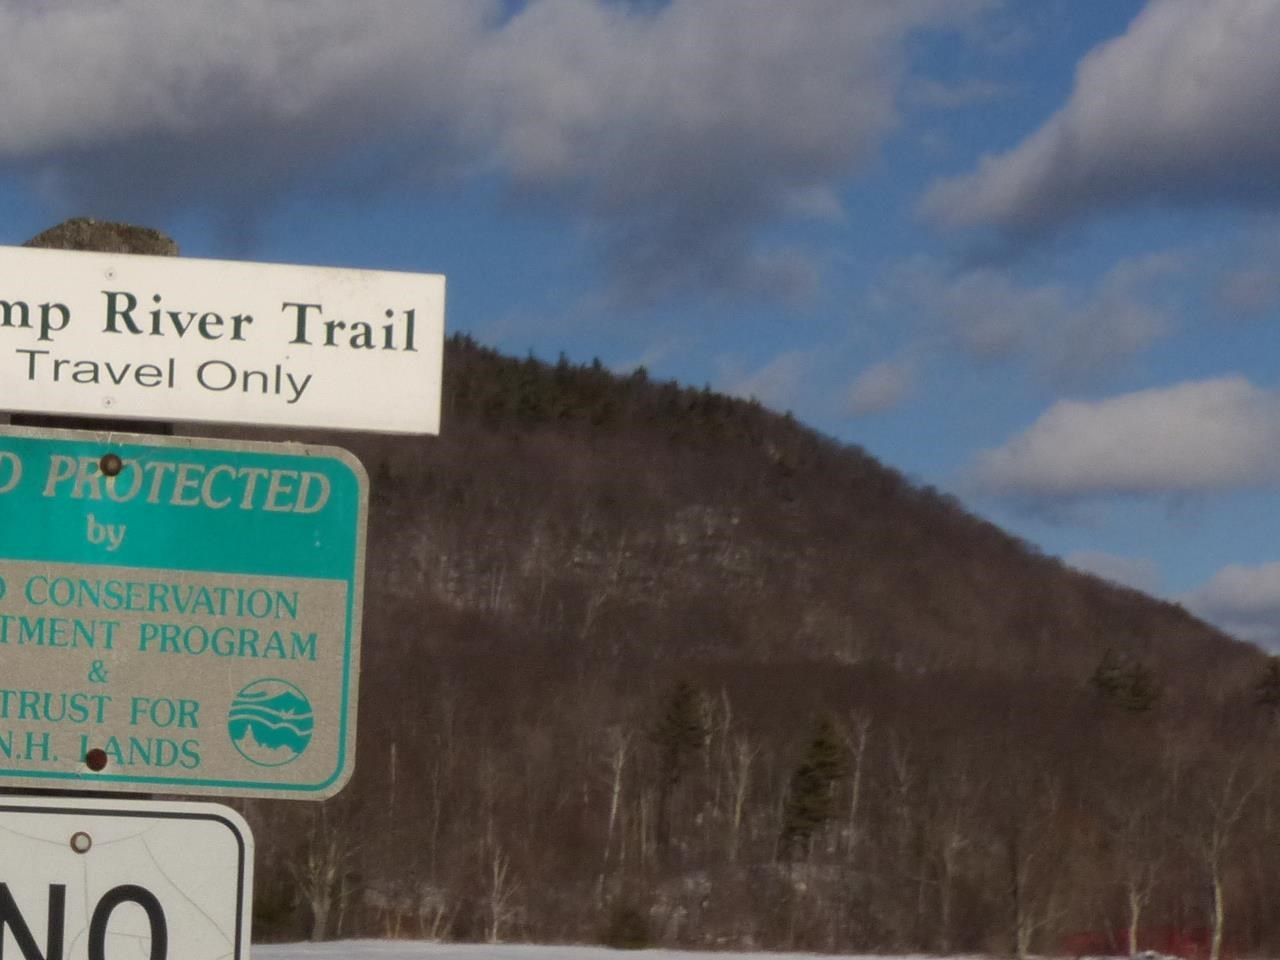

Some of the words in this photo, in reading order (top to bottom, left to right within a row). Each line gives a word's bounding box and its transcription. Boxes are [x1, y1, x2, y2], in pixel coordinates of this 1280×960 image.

[100, 290, 254, 342] River
[282, 301, 420, 352] Trail
[15, 349, 175, 388] Travel
[196, 360, 313, 404] Only
[42, 455, 331, 514] PROTECTED
[86, 513, 127, 551] by
[25, 576, 299, 620] CONSERVATION
[138, 623, 318, 661] PROGRAM
[87, 660, 110, 684] &
[129, 696, 200, 729] FOR
